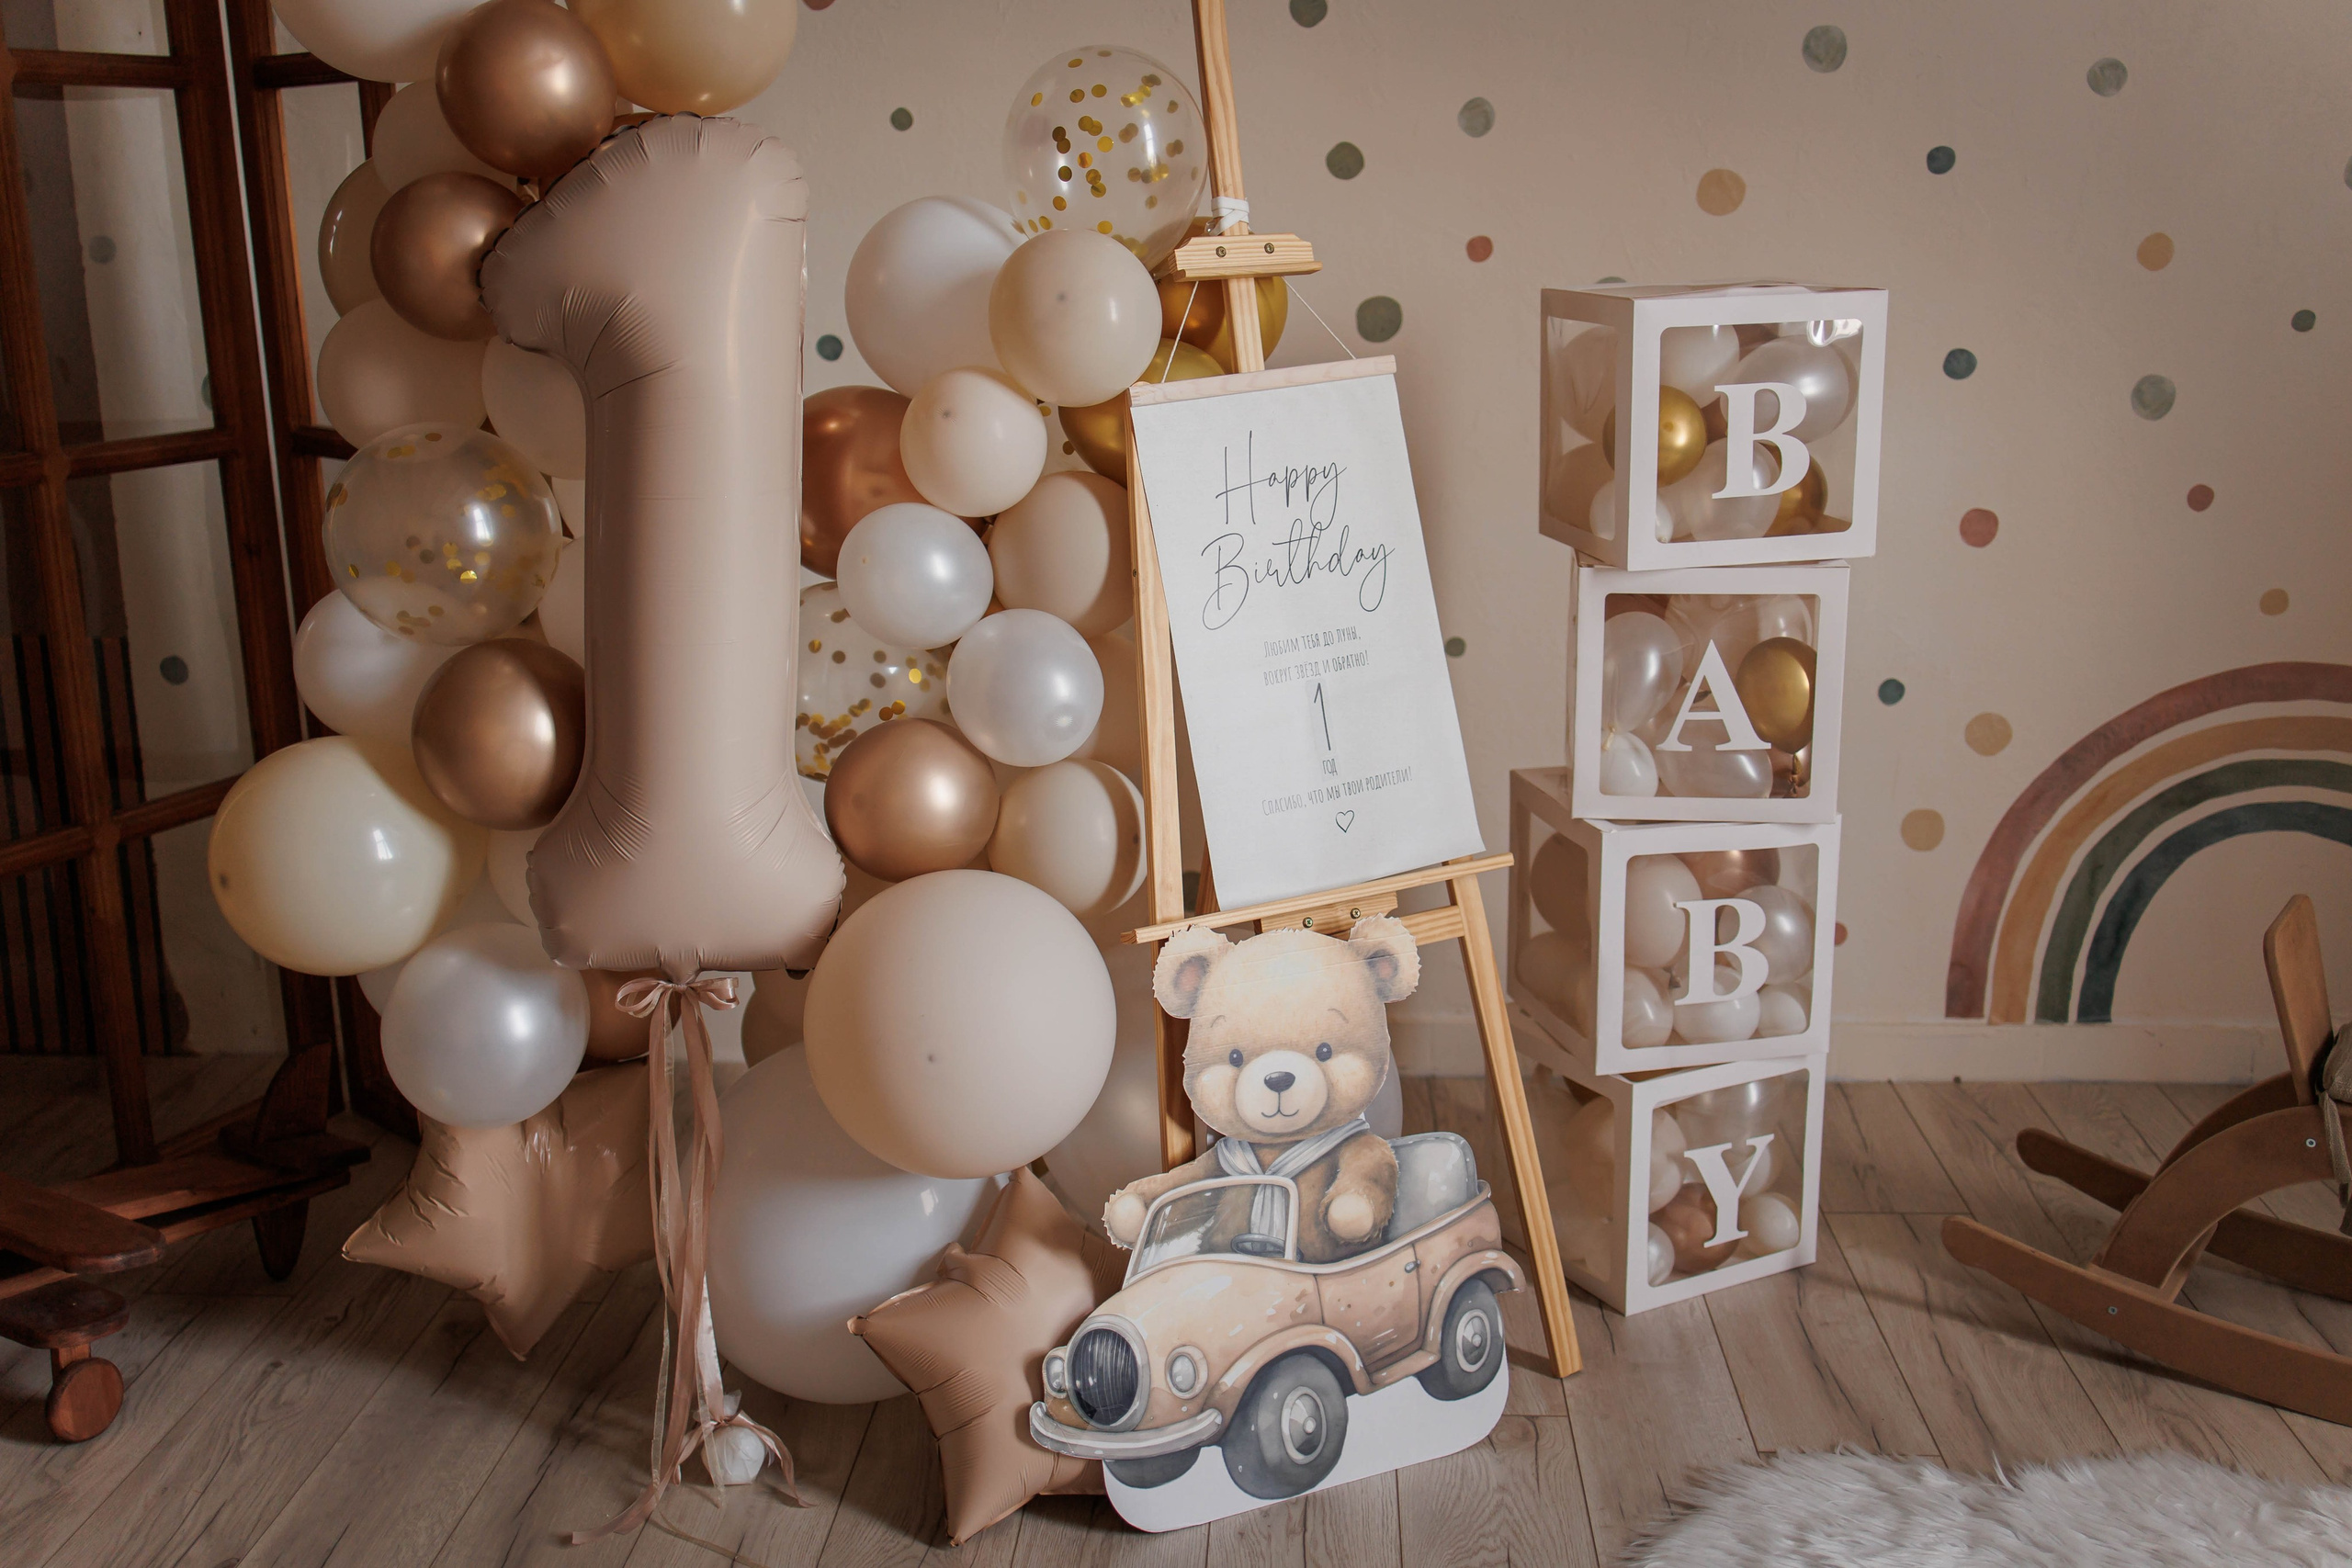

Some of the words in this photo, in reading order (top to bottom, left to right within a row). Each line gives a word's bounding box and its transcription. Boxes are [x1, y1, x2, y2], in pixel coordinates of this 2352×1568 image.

[1215, 430, 1348, 531] Happy
[1201, 518, 1396, 631] Birthday
[1313, 682, 1332, 751] 1
